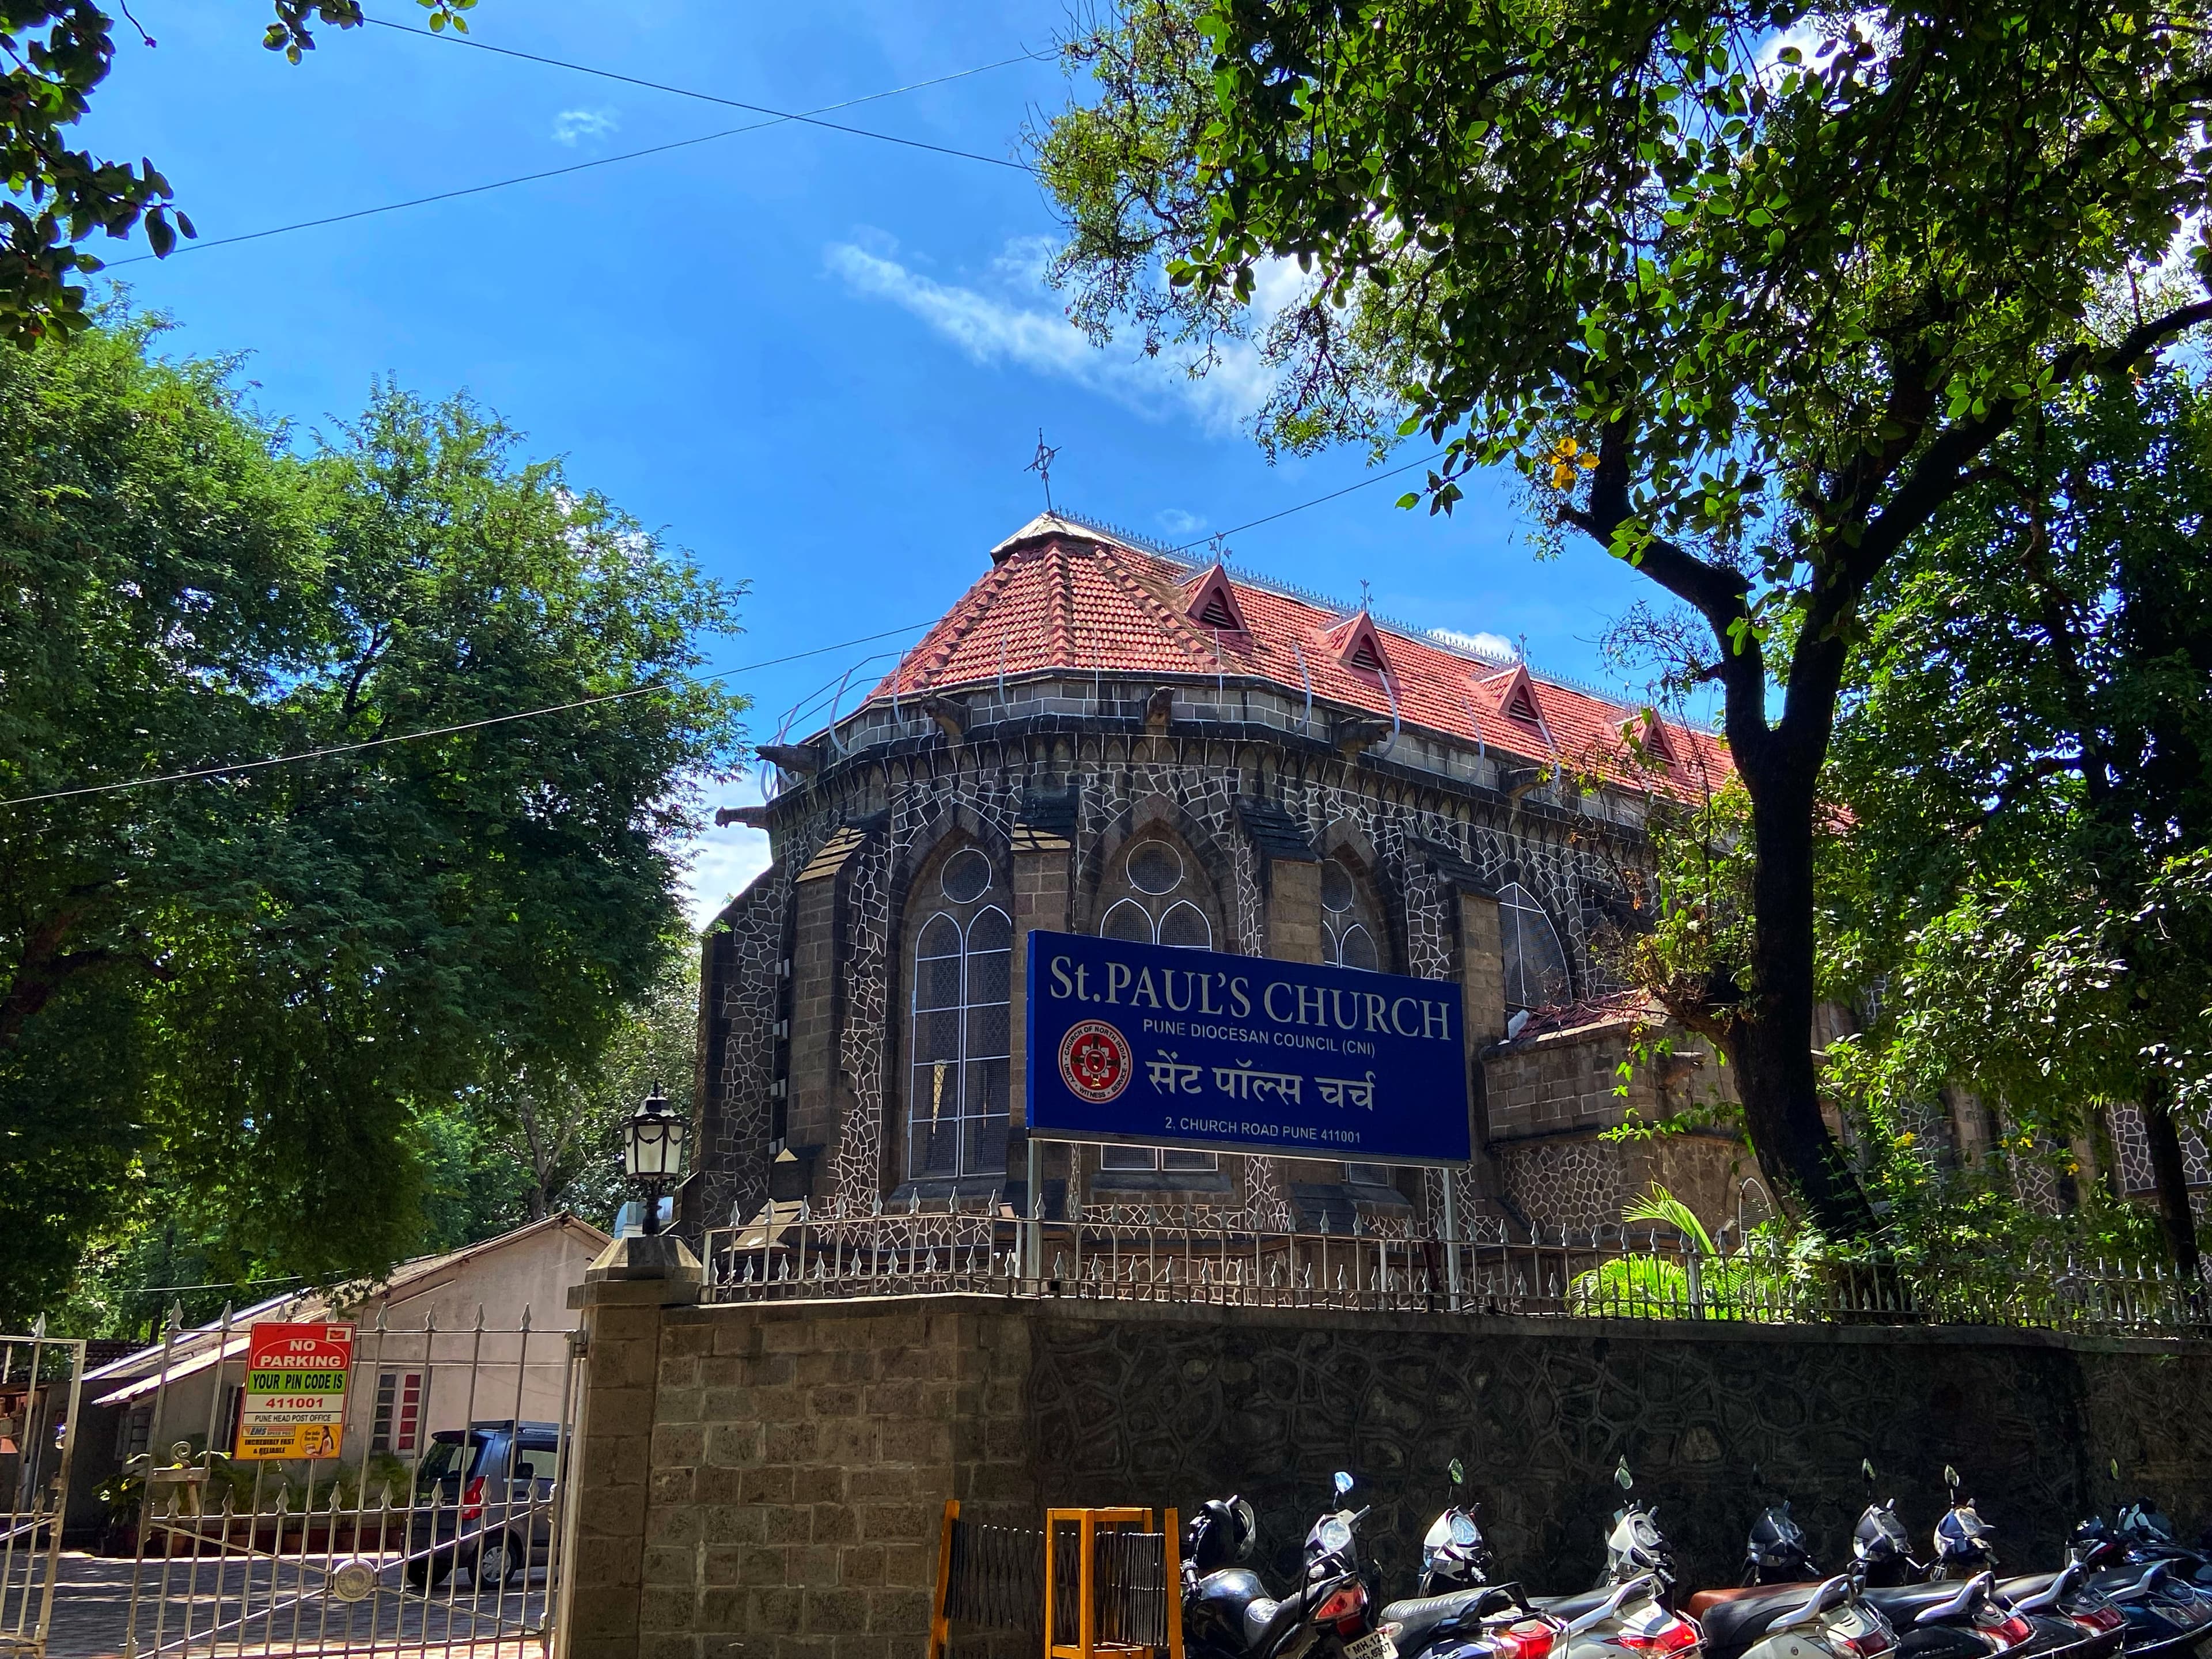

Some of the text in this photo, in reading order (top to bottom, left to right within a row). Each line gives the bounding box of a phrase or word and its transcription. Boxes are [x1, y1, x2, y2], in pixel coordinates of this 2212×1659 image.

[1263, 982, 1452, 1040] CHURCH
[1065, 1029, 1083, 1056] CHURCH
[1094, 1026, 1116, 1041] NORTH
[1115, 1040, 1127, 1060] INDIA
[1143, 1019, 1376, 1058] PUNE DIOCESAN COUNCIL (CNI)
[1064, 1063, 1127, 1098] UNITY WITNESS SERVICE
[1145, 1049, 1376, 1112] सेंट पॉल्स चर्च
[1165, 1116, 1361, 1143] 2, CHURCH ROAD PUNE 411001
[289, 1340, 316, 1351] NO
[260, 1355, 341, 1367] PARKING
[253, 1374, 343, 1389] YOUR PIN CODE IS
[266, 1398, 323, 1408] 411001
